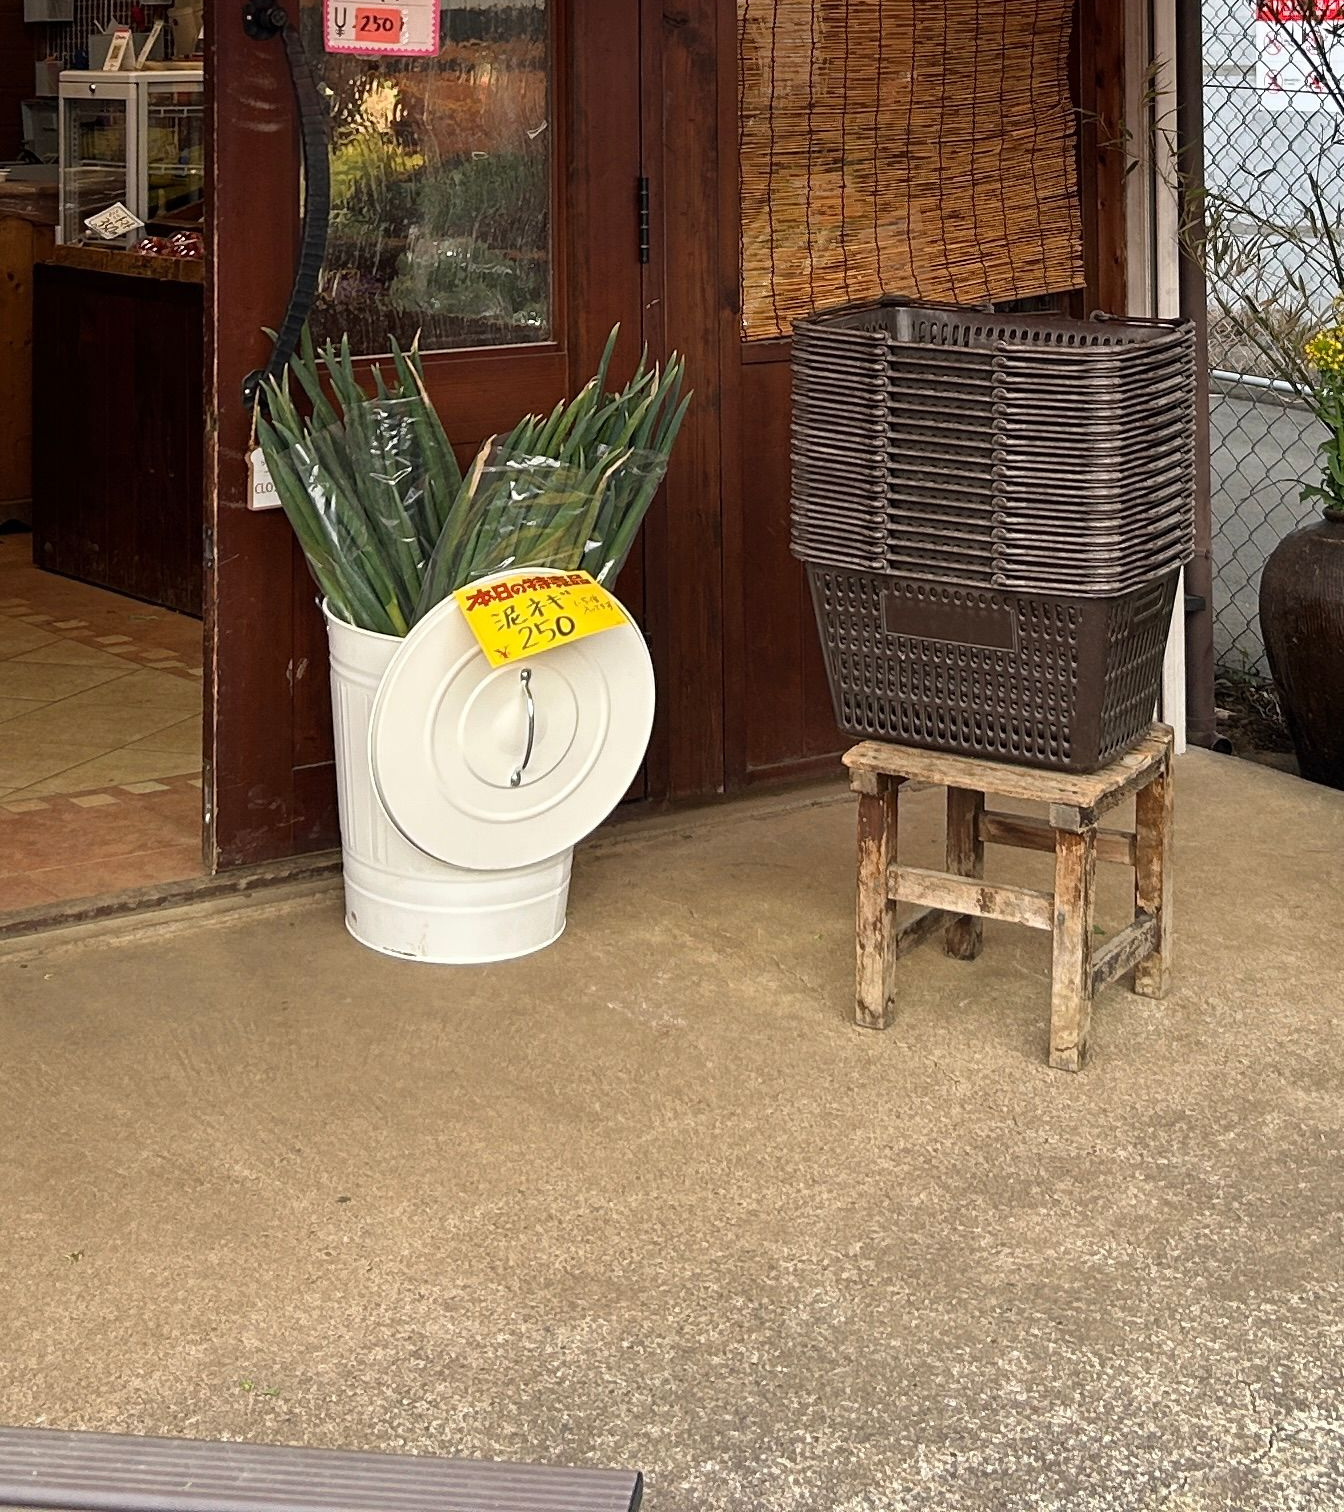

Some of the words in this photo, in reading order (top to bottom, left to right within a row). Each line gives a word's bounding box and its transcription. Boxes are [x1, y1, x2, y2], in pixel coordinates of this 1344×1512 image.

[359, 14, 395, 33] 250
[465, 573, 593, 613] 本日の特売品
[491, 589, 572, 632] 泥ネギ
[517, 615, 576, 651] 250
